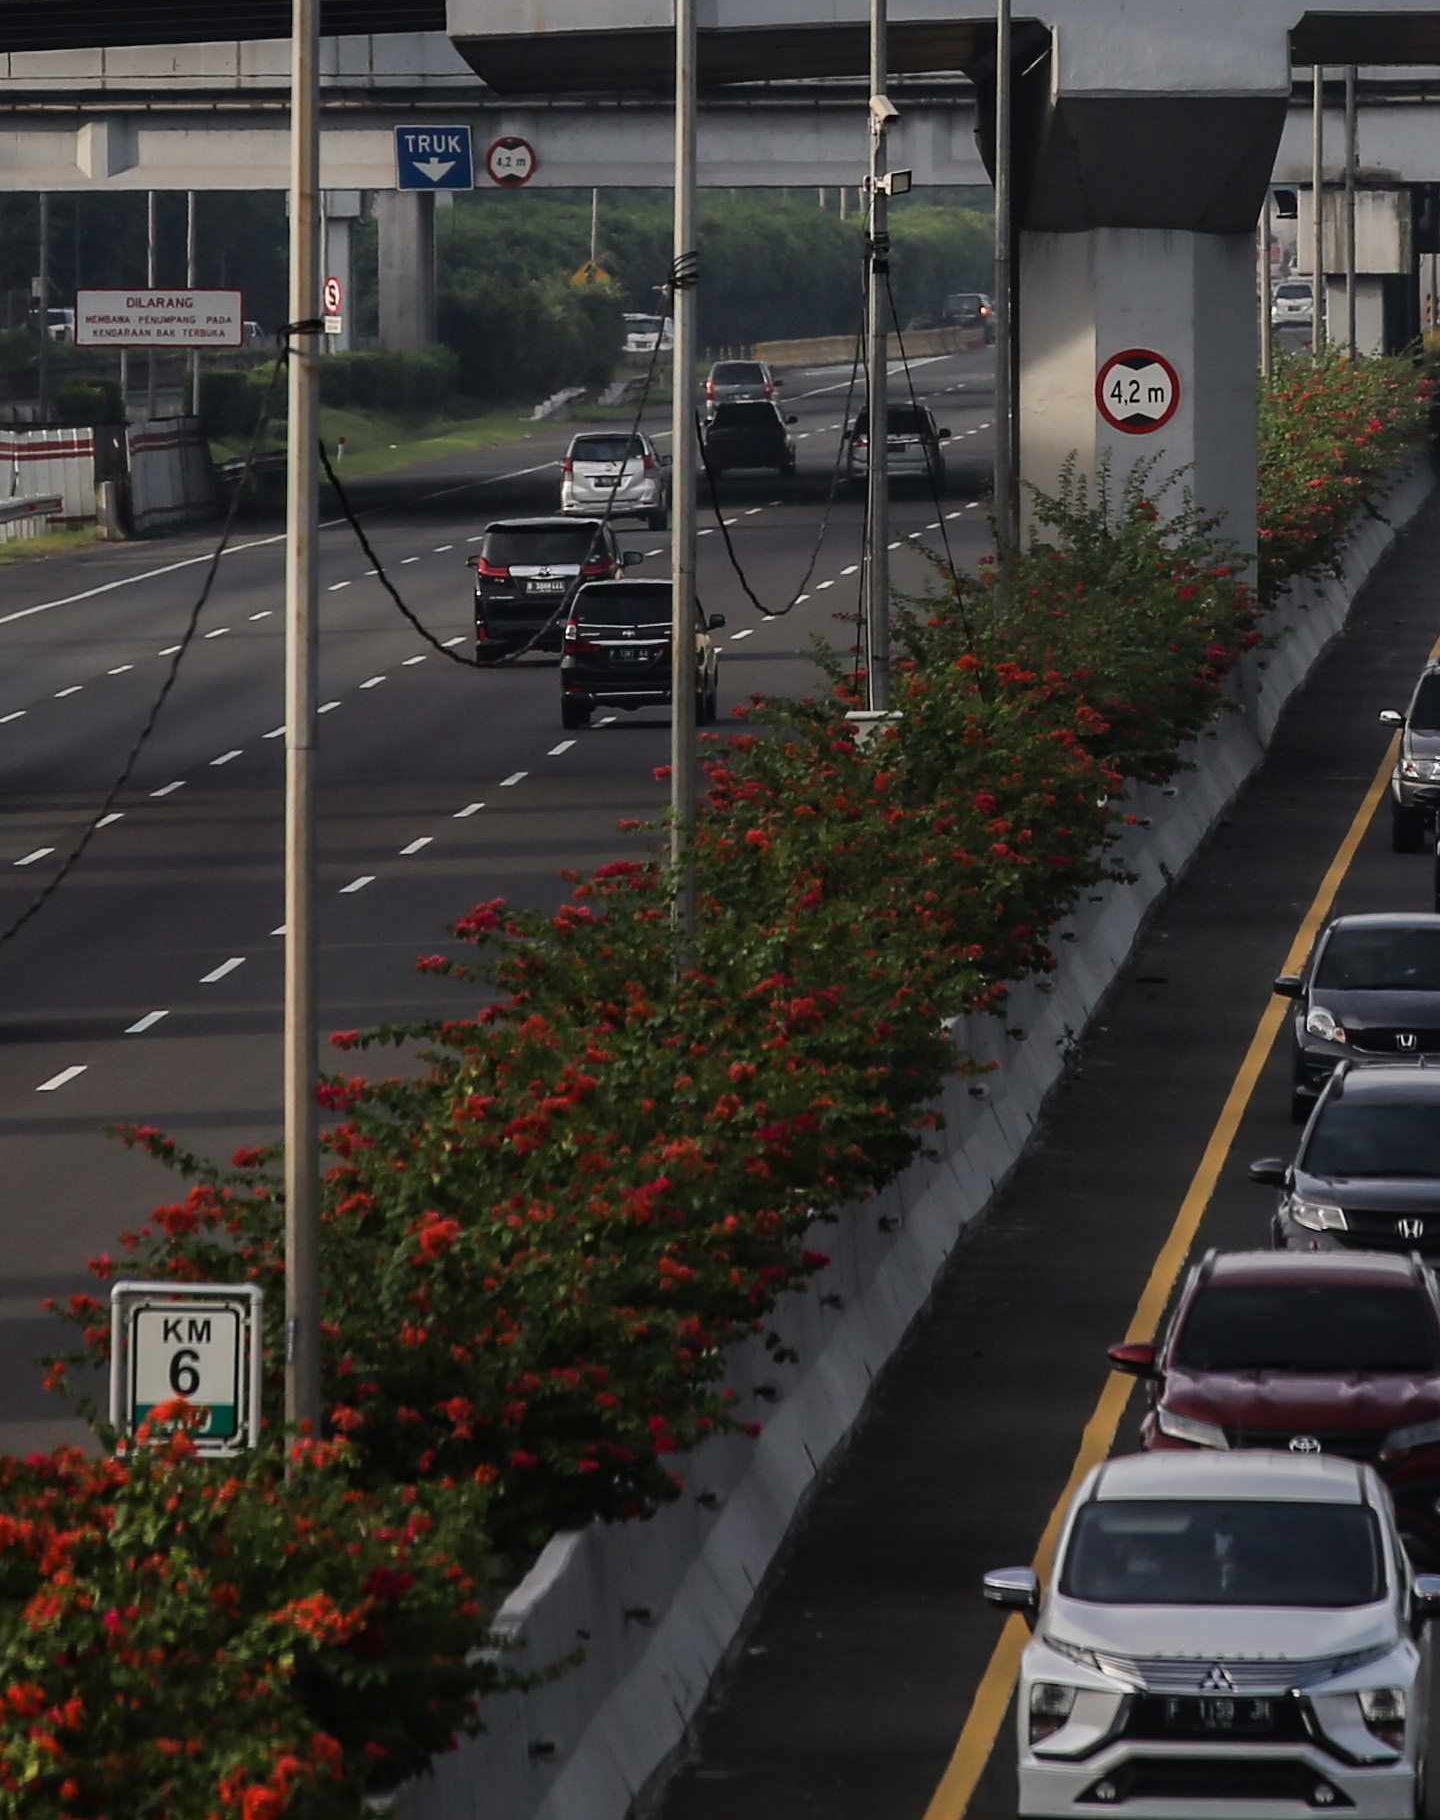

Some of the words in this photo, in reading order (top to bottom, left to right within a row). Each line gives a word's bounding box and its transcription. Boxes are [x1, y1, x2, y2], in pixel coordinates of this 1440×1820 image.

[404, 135, 462, 153] TRUK
[516, 157, 526, 167] m
[126, 297, 194, 309] DILARANG
[85, 315, 130, 324] MEMBAWA
[138, 315, 196, 324] PENUMPANG
[206, 315, 233, 324] PADA
[92, 328, 152, 338] KENDARAAN
[182, 328, 225, 338] TERBUKA
[1110, 379, 1140, 405] 4,2
[1148, 386, 1164, 403] m
[163, 1317, 212, 1344] KM
[168, 1348, 201, 1395] 6
